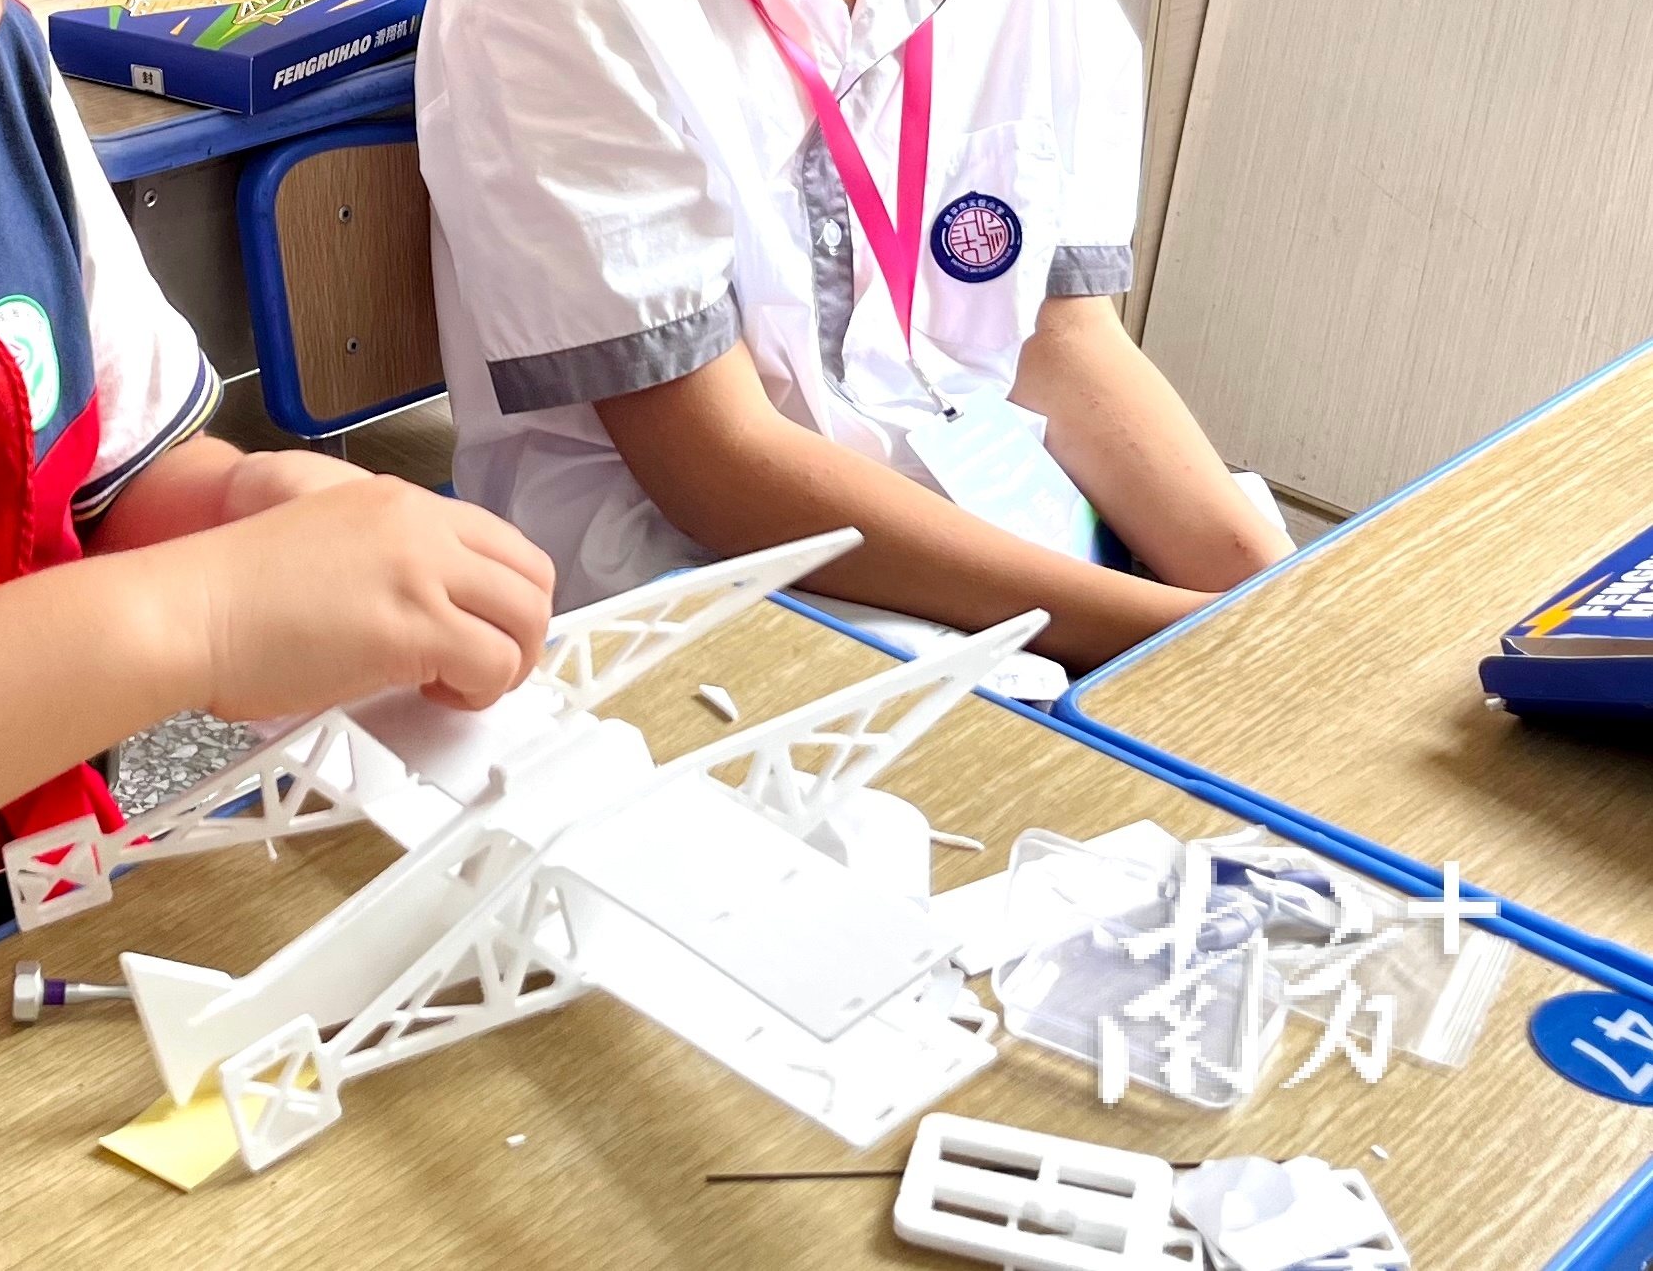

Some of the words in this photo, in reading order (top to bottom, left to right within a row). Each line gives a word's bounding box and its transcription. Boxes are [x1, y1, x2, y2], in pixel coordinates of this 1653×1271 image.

[273, 34, 372, 90] FENGRUHAO
[374, 19, 408, 49] 滑翔机
[1570, 1008, 1653, 1095] 47
